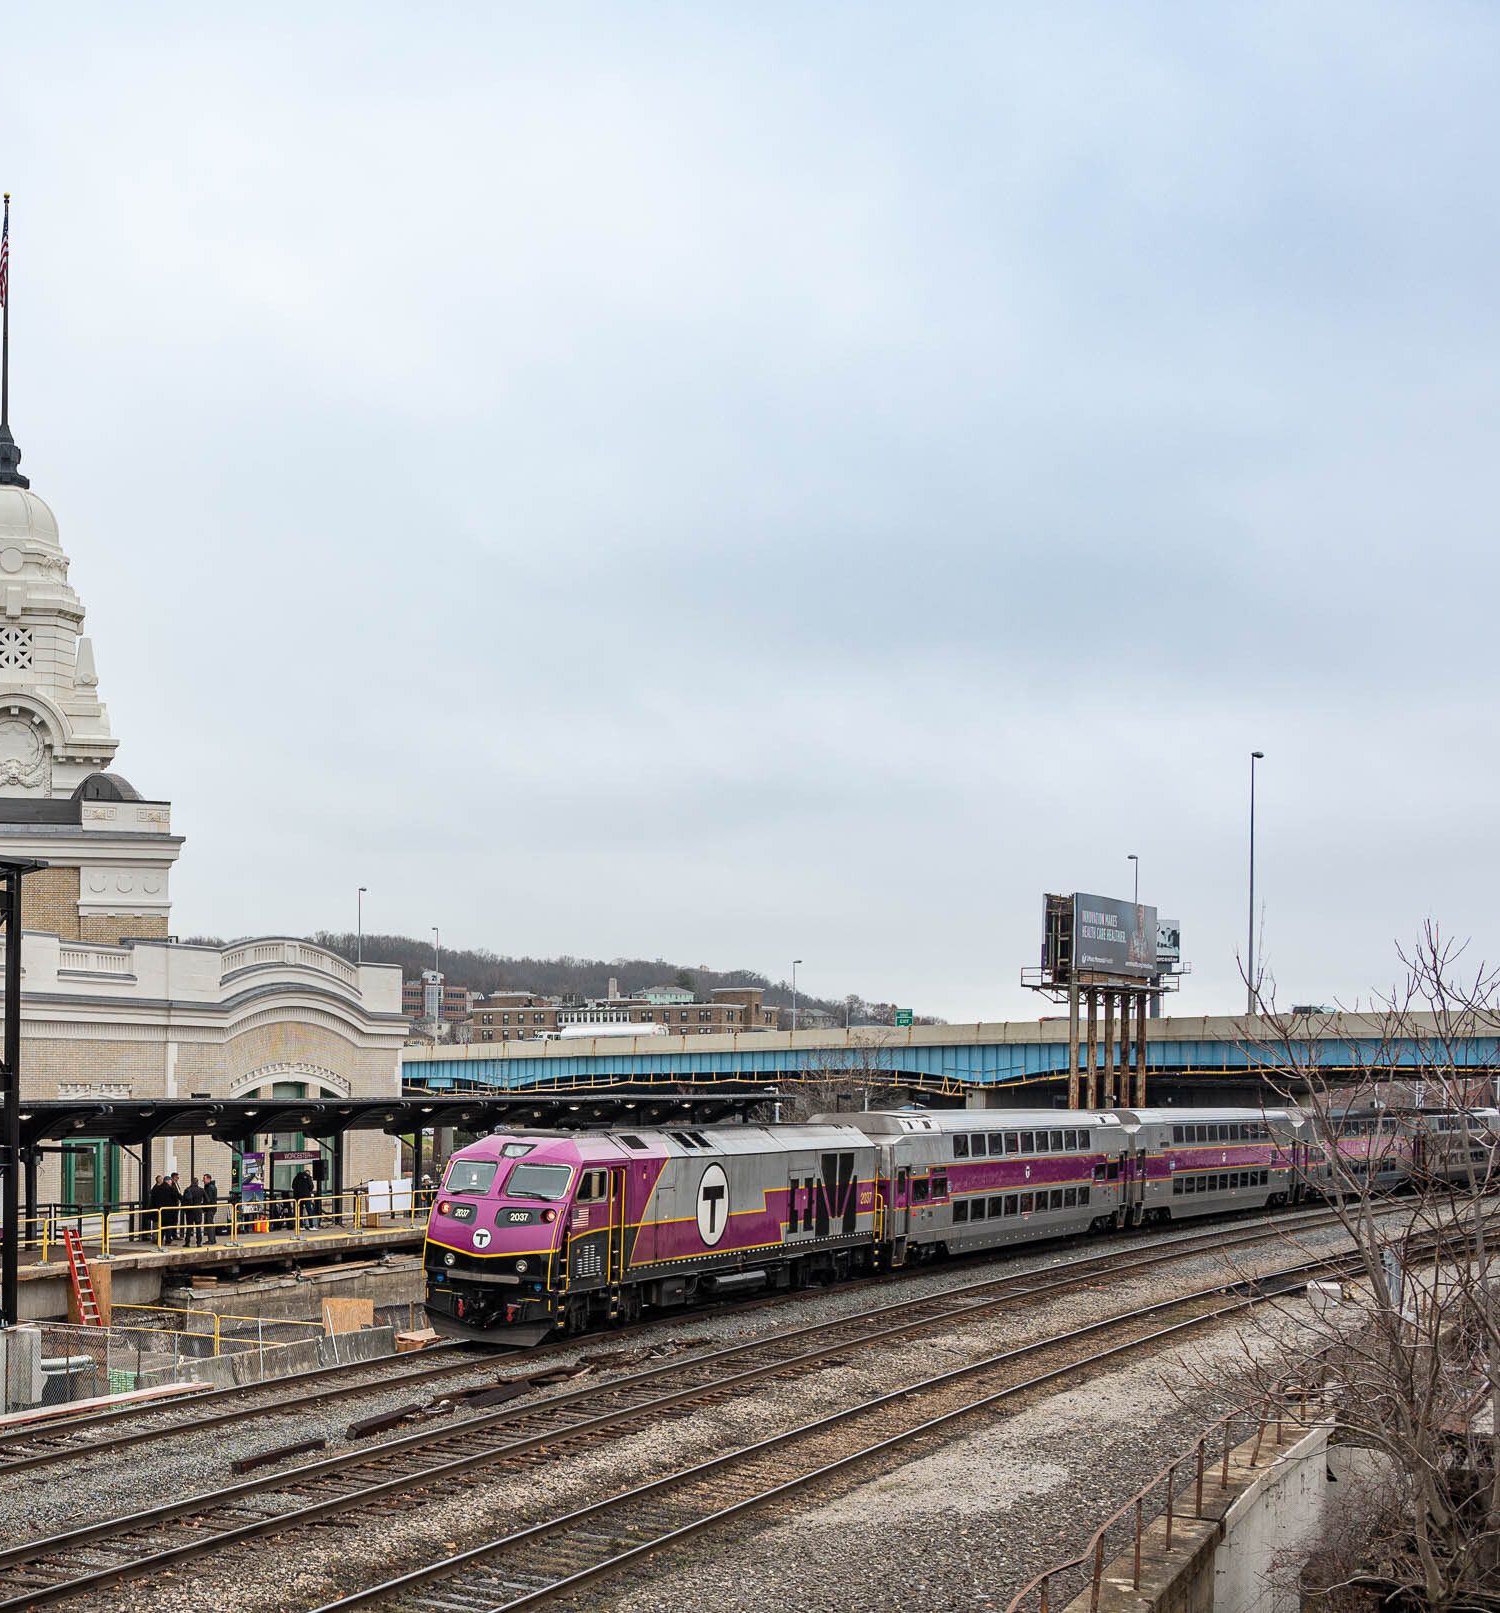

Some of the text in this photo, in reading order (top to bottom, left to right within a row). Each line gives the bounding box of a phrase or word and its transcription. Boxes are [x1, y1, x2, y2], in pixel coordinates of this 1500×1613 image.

[1082, 910, 1118, 927] INNOVATION MAKES
[1082, 926, 1096, 939] HEALTH
[1097, 927, 1106, 940] CARE
[860, 1191, 872, 1205] 2037
[454, 1208, 470, 1218] 2037
[702, 1185, 725, 1233] T
[510, 1213, 528, 1222] 2037
[475, 1233, 488, 1246] T
